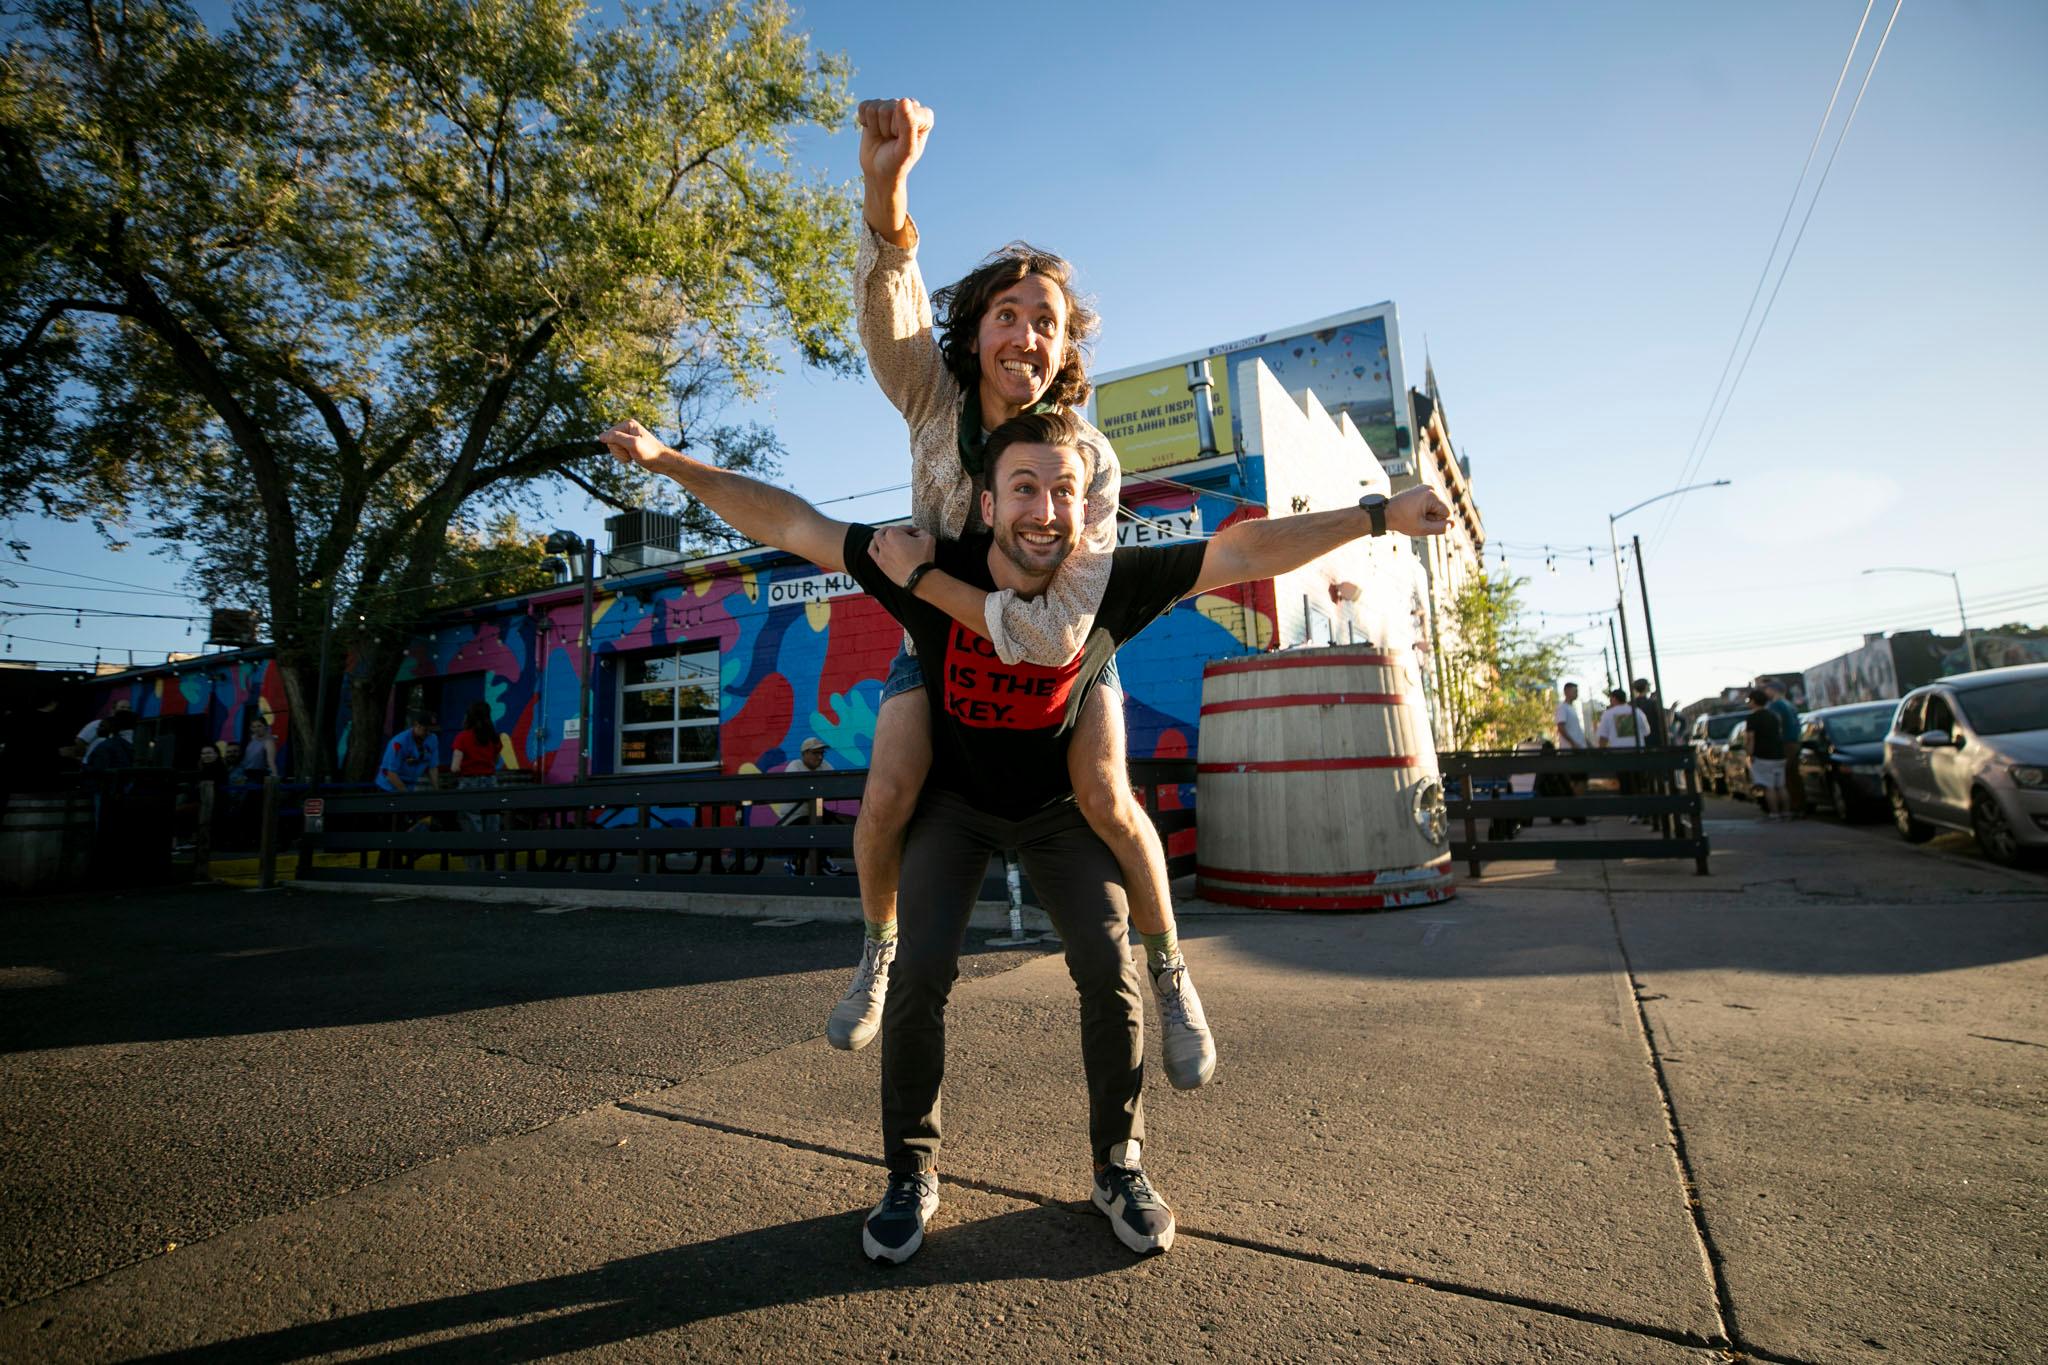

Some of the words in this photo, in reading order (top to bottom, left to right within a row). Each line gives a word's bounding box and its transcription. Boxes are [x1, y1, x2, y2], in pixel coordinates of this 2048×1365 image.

[1104, 411, 1138, 427] WHERE
[1141, 405, 1162, 420] AWE
[1165, 393, 1220, 414] INSPIG
[1136, 418, 1166, 433] AHHH
[1169, 406, 1224, 427] INSPIG
[771, 581, 814, 602] OUR
[950, 663, 976, 689] IS
[987, 671, 1057, 697] THE
[949, 691, 1016, 723] KEY.
